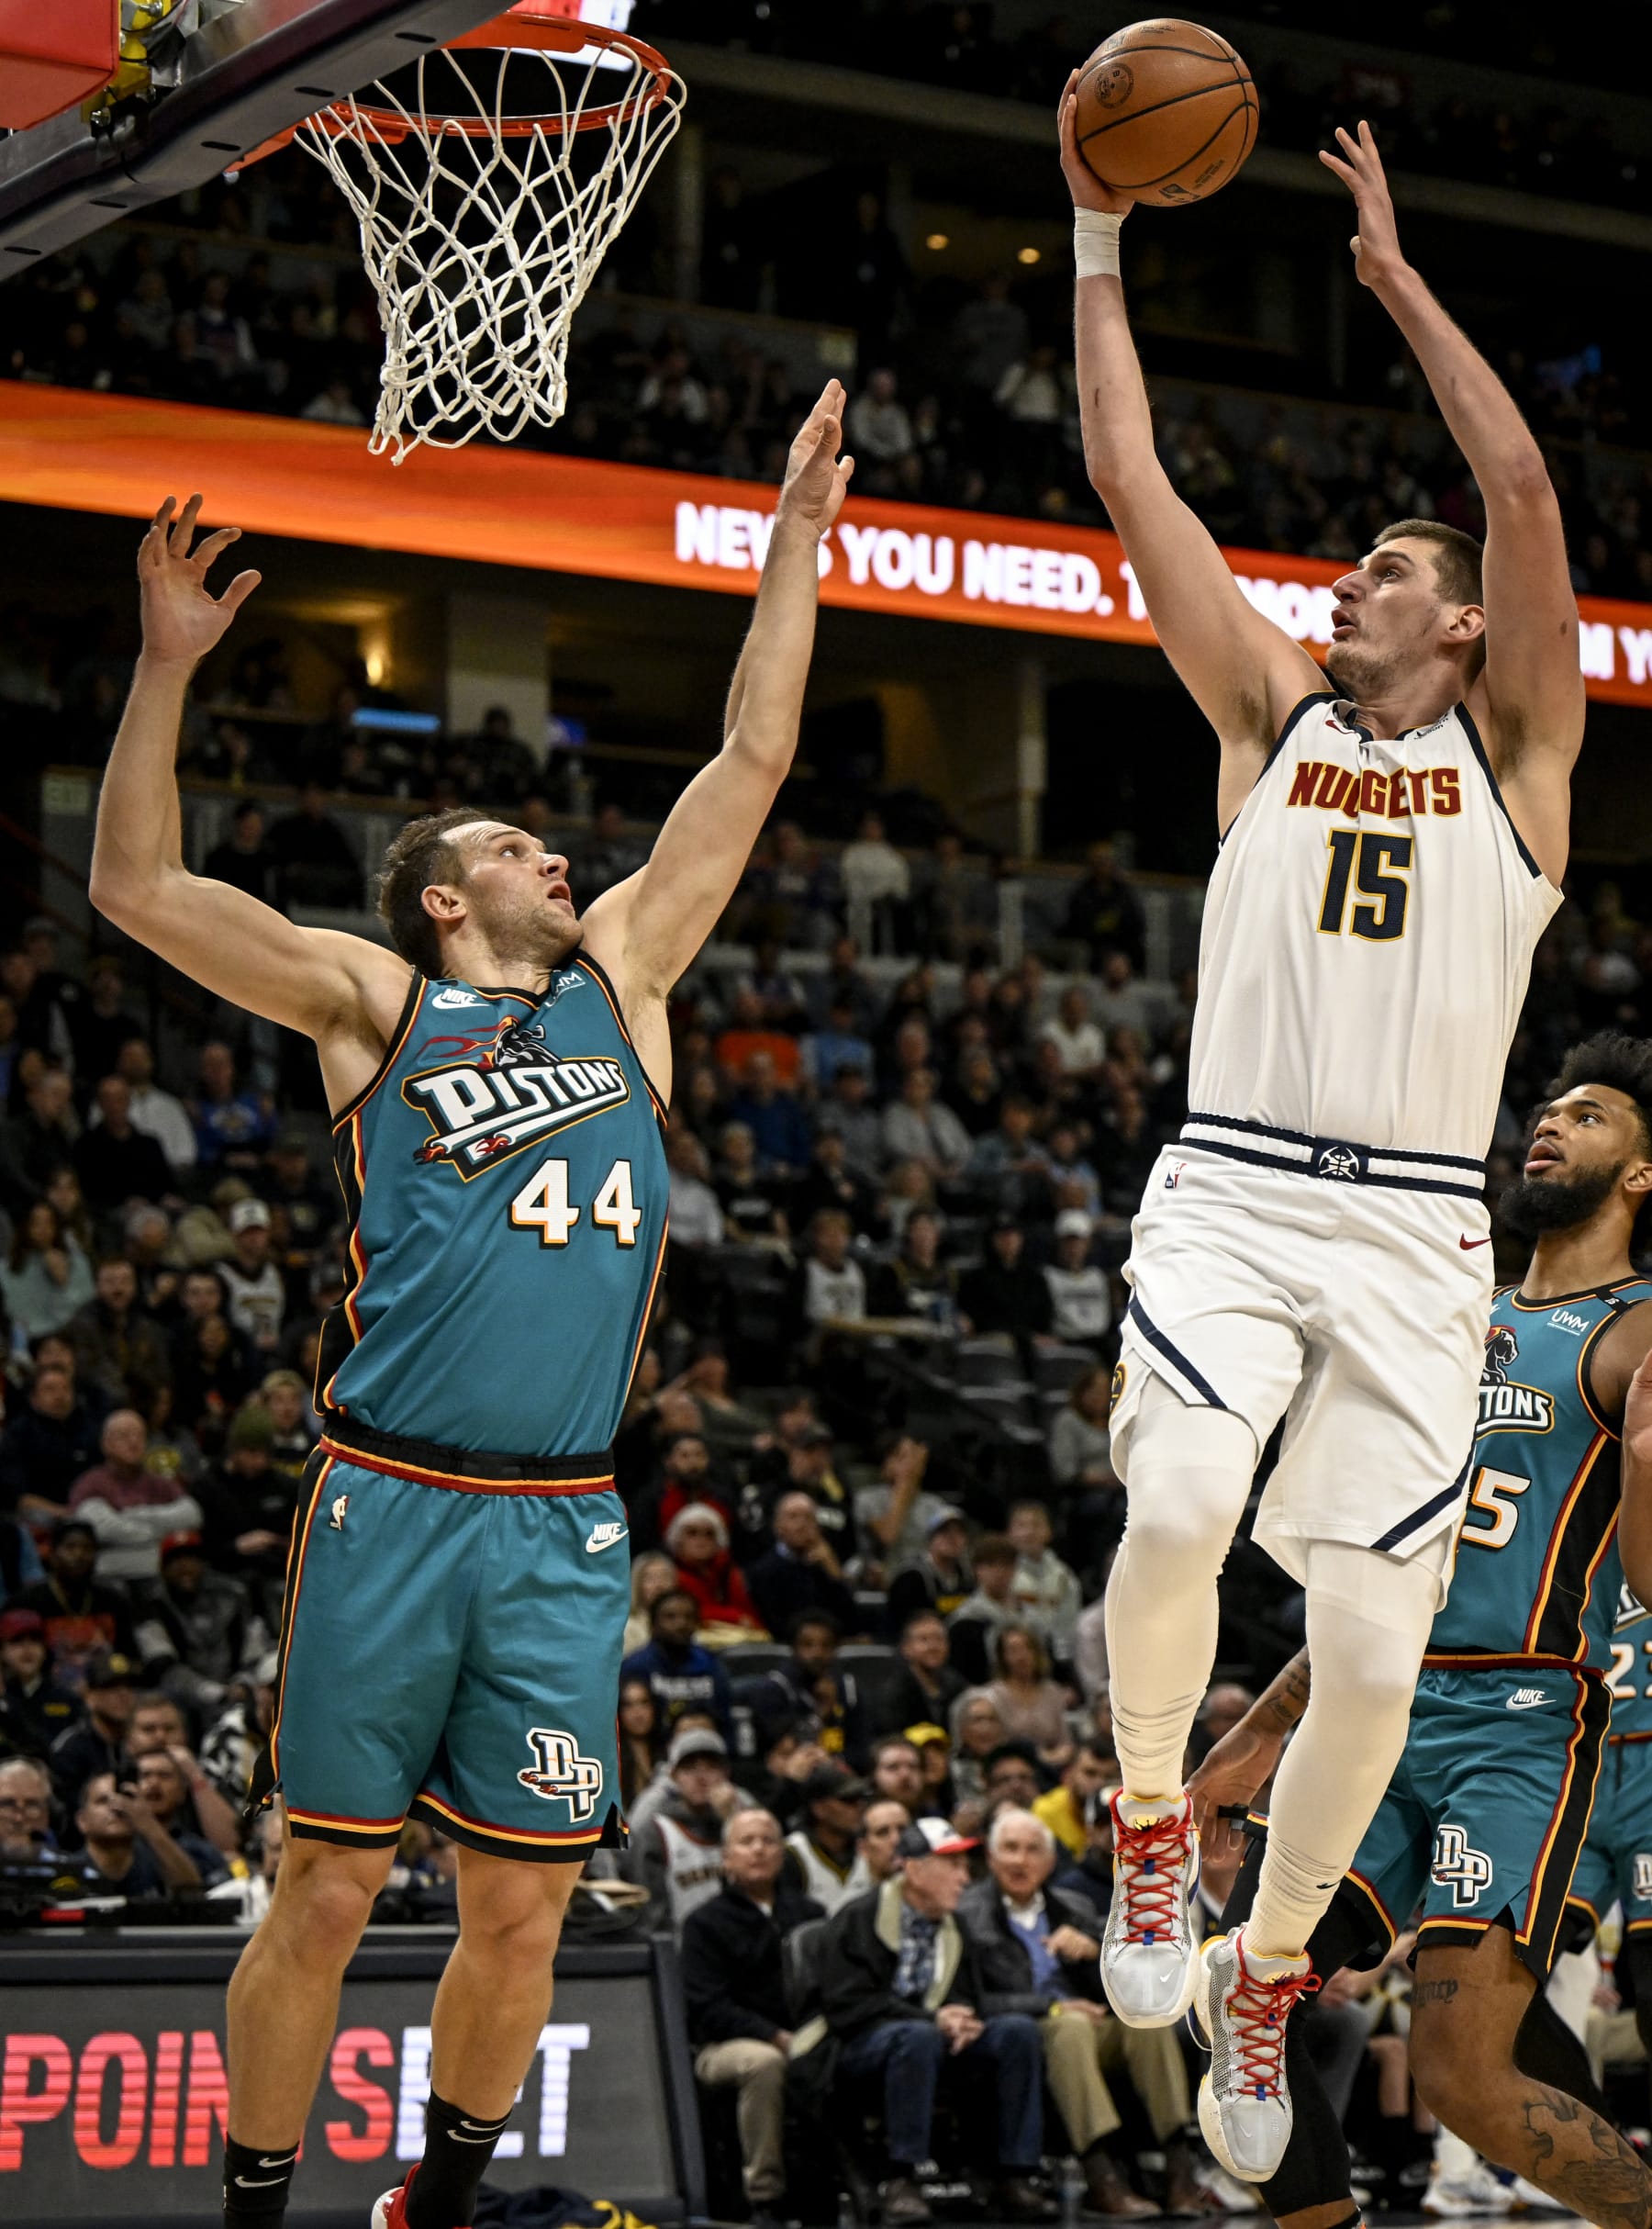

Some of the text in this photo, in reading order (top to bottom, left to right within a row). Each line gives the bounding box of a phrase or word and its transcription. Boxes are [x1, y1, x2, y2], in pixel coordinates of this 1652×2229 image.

[837, 522, 954, 595] YOU
[962, 540, 1114, 616] NEED.
[1286, 760, 1464, 820] NUGGETS
[1316, 827, 1414, 943] 15
[441, 988, 477, 1005] NIKE
[407, 1060, 630, 1166] PISTONS
[508, 1158, 642, 1249] 44
[1551, 1308, 1590, 1332] UWM
[1478, 1384, 1549, 1428] TONS
[593, 1522, 621, 1540] NIKE
[1513, 1688, 1546, 1703] NIKE
[1603, 1641, 1652, 1699] 2
